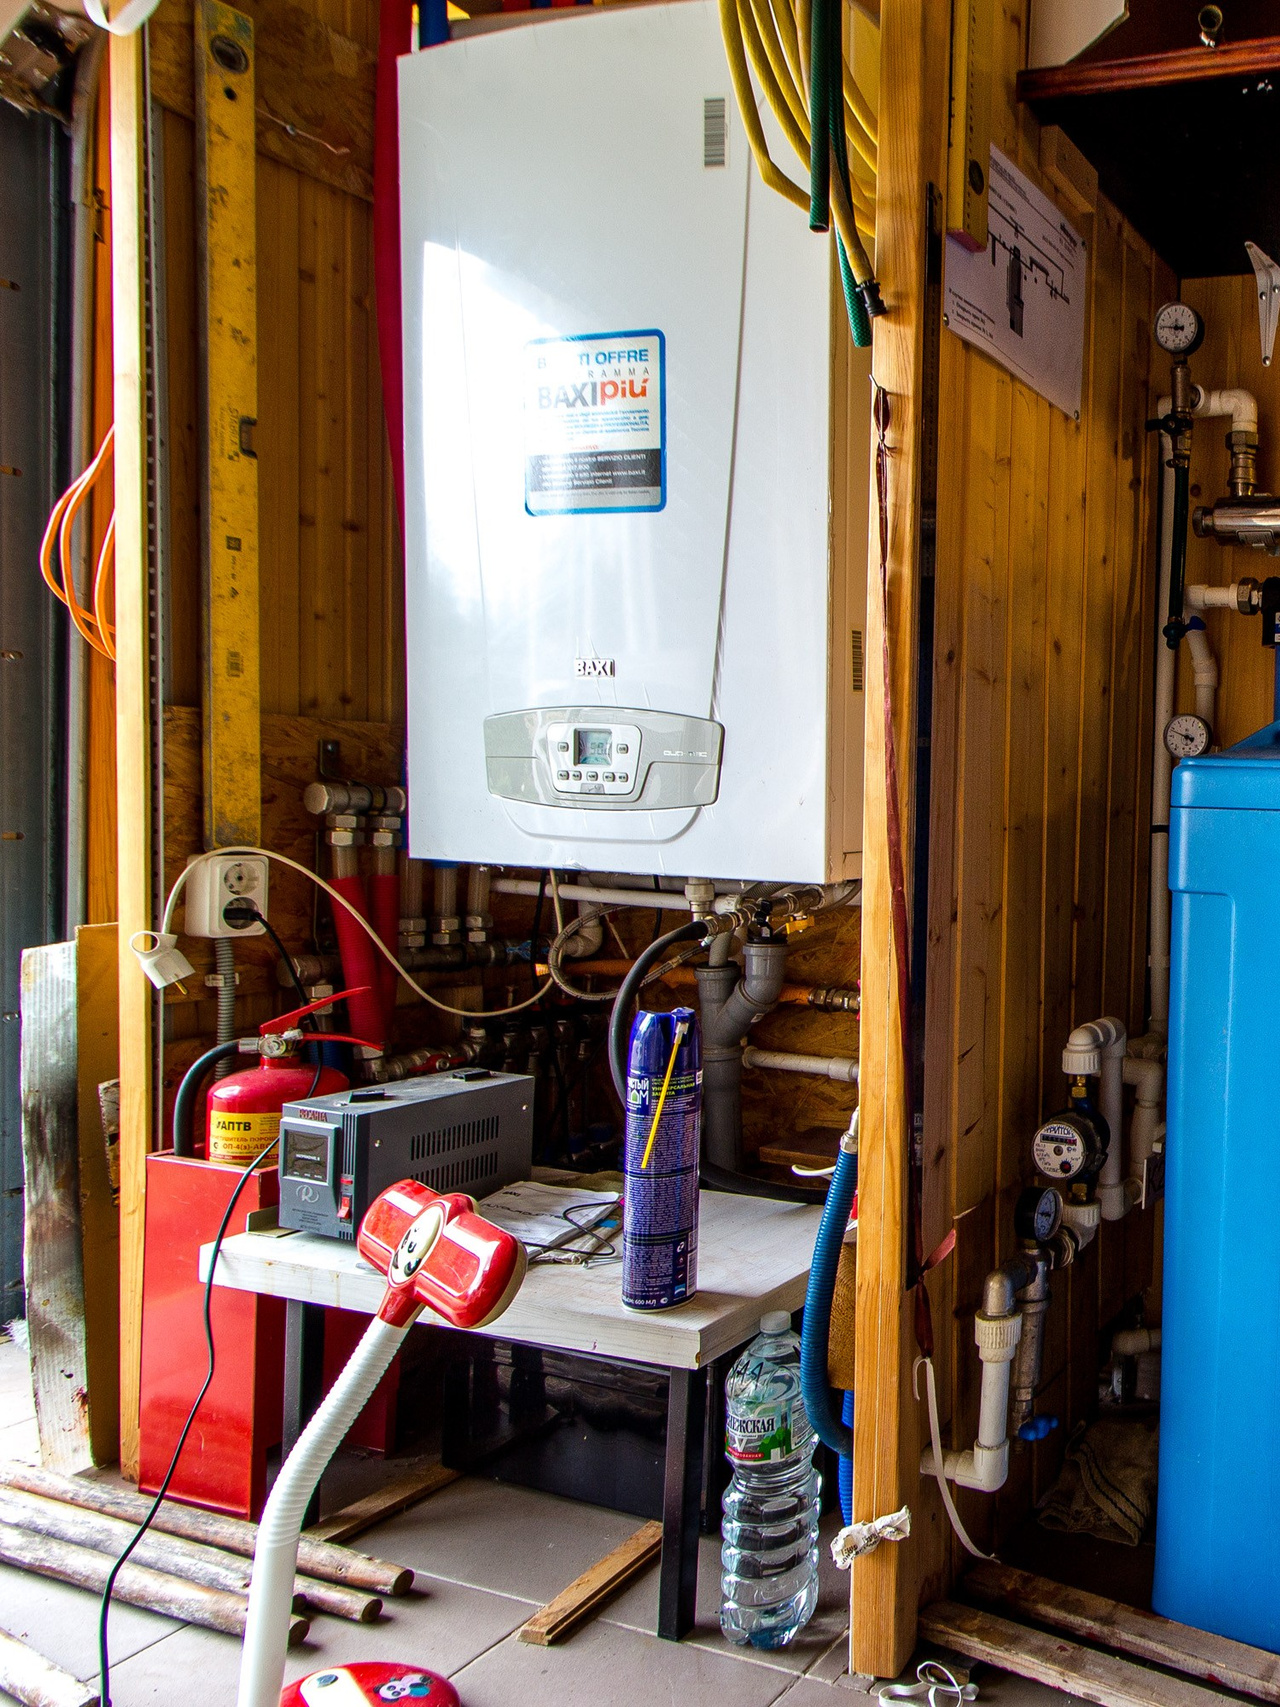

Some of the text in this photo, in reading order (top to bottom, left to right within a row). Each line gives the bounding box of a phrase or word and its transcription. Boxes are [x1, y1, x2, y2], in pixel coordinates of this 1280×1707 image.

[595, 348, 649, 366] OFFRE
[587, 366, 650, 379] RAMMA
[575, 658, 615, 677] BAXI
